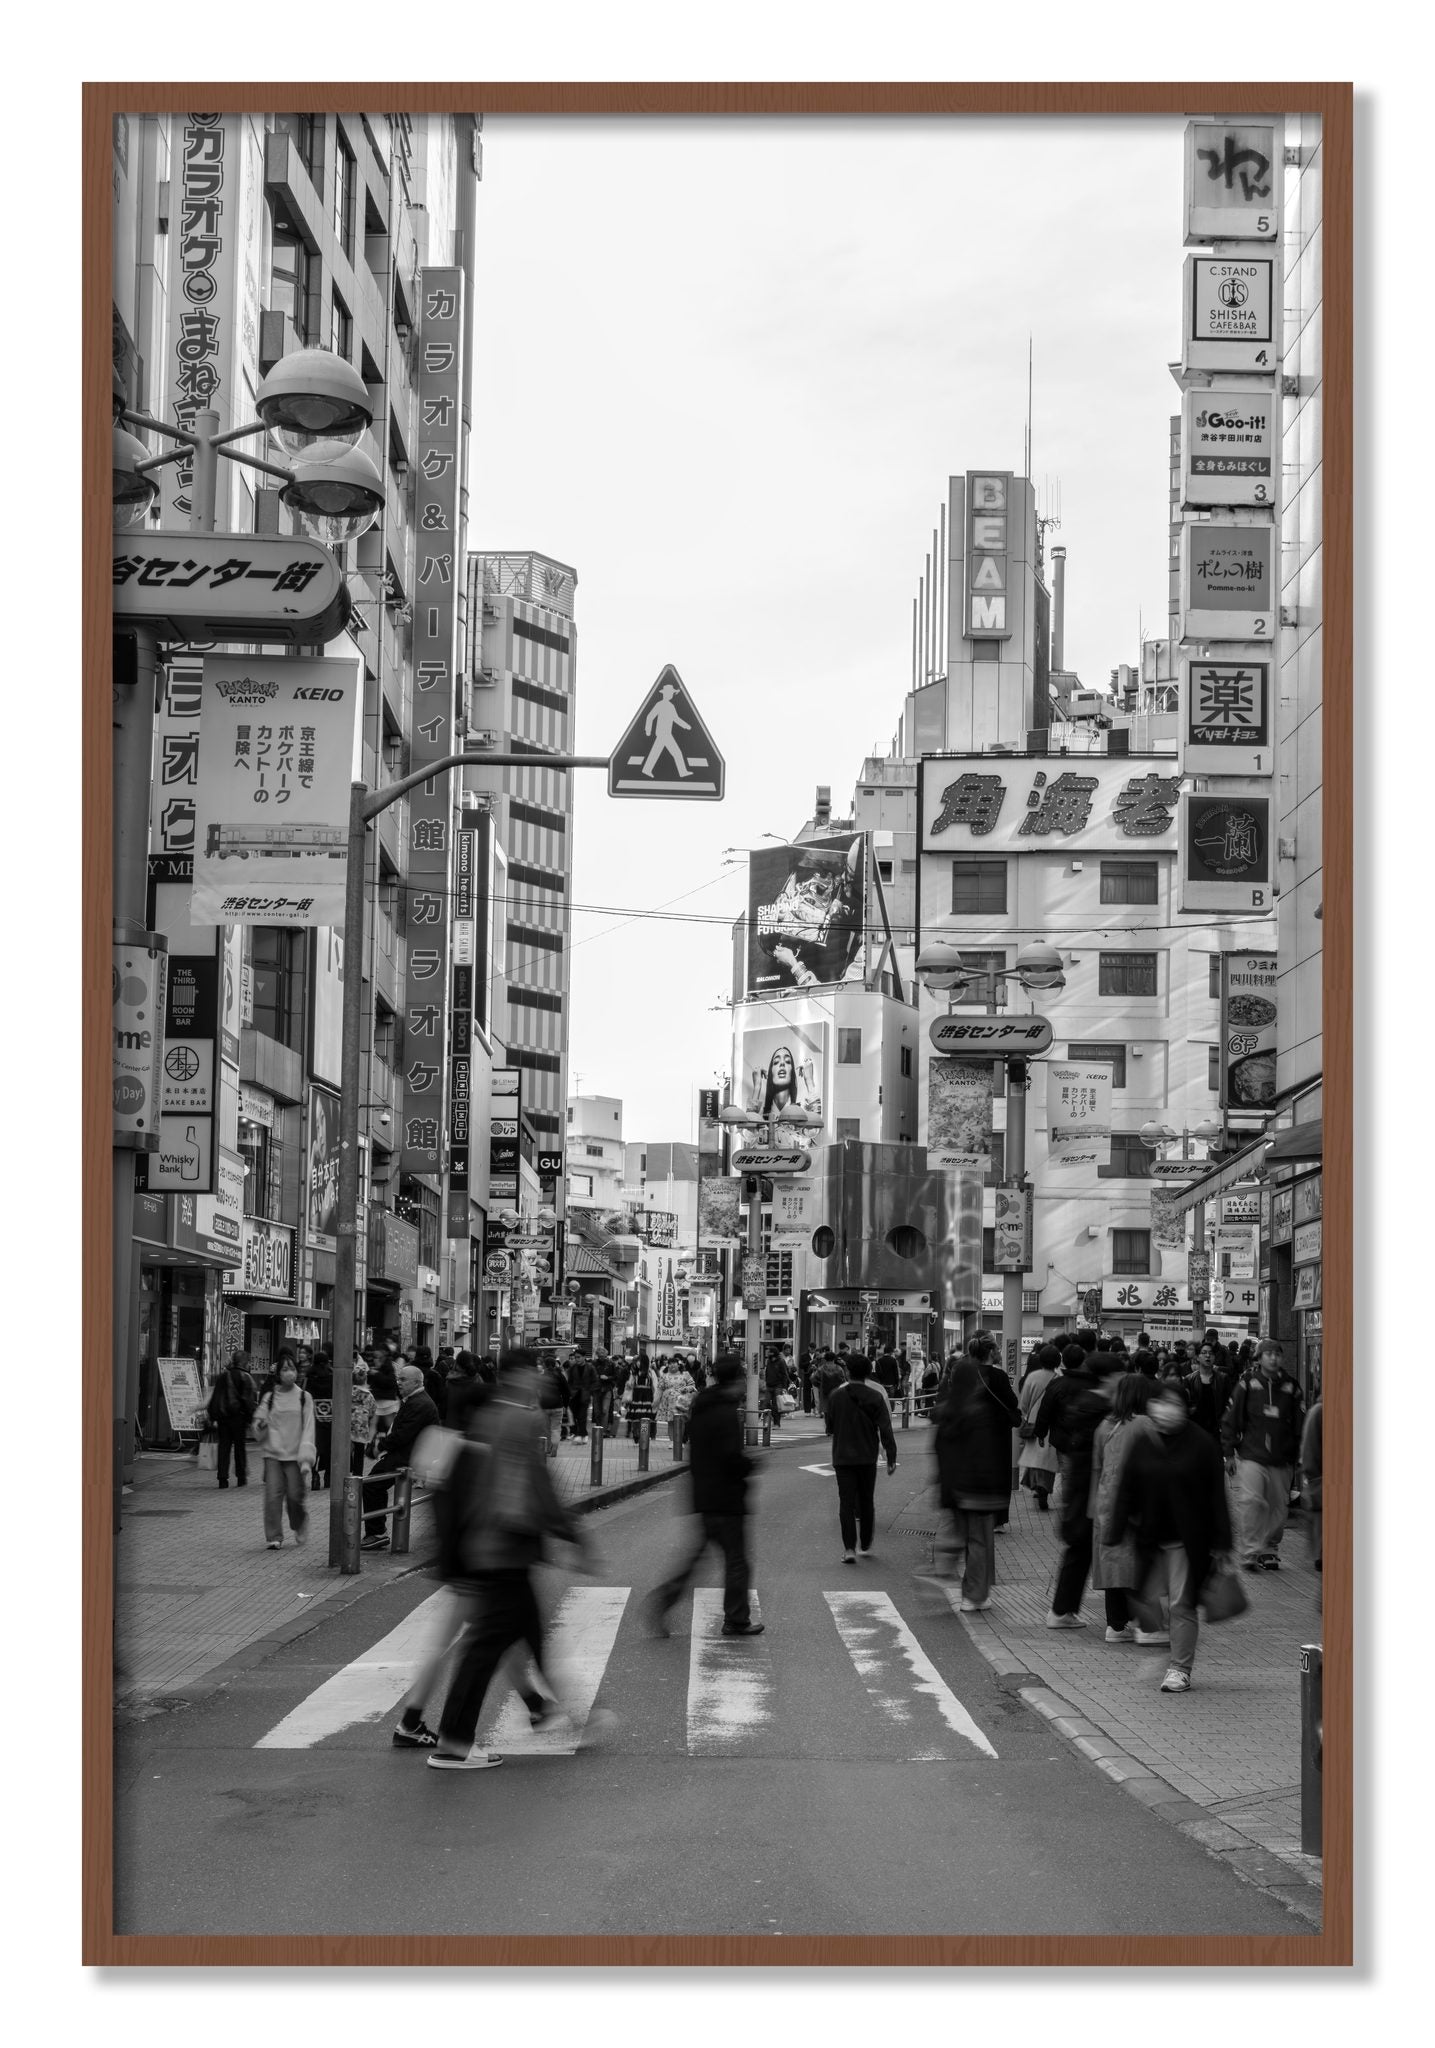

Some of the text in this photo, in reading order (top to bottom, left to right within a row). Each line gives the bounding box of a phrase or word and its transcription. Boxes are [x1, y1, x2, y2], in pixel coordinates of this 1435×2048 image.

[181, 127, 224, 272] カラオケ
[1257, 216, 1270, 232] 5
[1209, 266, 1258, 277] C.STAND
[1209, 309, 1257, 321] SHISHA
[1209, 321, 1257, 330] CAFE&BAR
[1208, 412, 1266, 429] Goo-it!
[1201, 433, 1263, 443] 渋谷宇田川町店
[1195, 460, 1267, 473] 全身もみほぐし
[1254, 484, 1267, 501] 3
[972, 477, 1006, 629] BEAM
[1196, 559, 1264, 580] ポムの樹
[1207, 584, 1256, 592] Pomme-no-ki
[1253, 618, 1266, 635] 2
[229, 696, 266, 704] KANTO
[292, 687, 344, 702] KEIO
[1199, 669, 1254, 724] 薬
[234, 725, 251, 770] 冒険へ
[298, 726, 316, 789] 京王線で
[1253, 754, 1262, 770] 1
[253, 726, 272, 804] カントーの
[930, 771, 1186, 836] 角海老
[461, 834, 470, 873] kimono
[220, 897, 315, 911] 渋谷センター街
[1252, 889, 1264, 906] B
[177, 969, 192, 977] THE
[1230, 973, 1277, 987] 四川料理
[172, 977, 196, 985] THIRD
[176, 1018, 191, 1026] BAR
[406, 893, 443, 1151] カラオケ館
[938, 1025, 1046, 1039] 渋谷センター街
[1228, 1035, 1258, 1055] 6F
[122, 1086, 143, 1102] Day!
[503, 1126, 517, 1135] UP
[159, 1154, 195, 1166] Whisky
[540, 1158, 561, 1169] GU
[736, 1154, 801, 1165] 渋谷センター街
[159, 1165, 180, 1174] Bank
[135, 1176, 145, 1187] 1F
[664, 1282, 675, 1328] BEER
[662, 1329, 676, 1337] HALL
